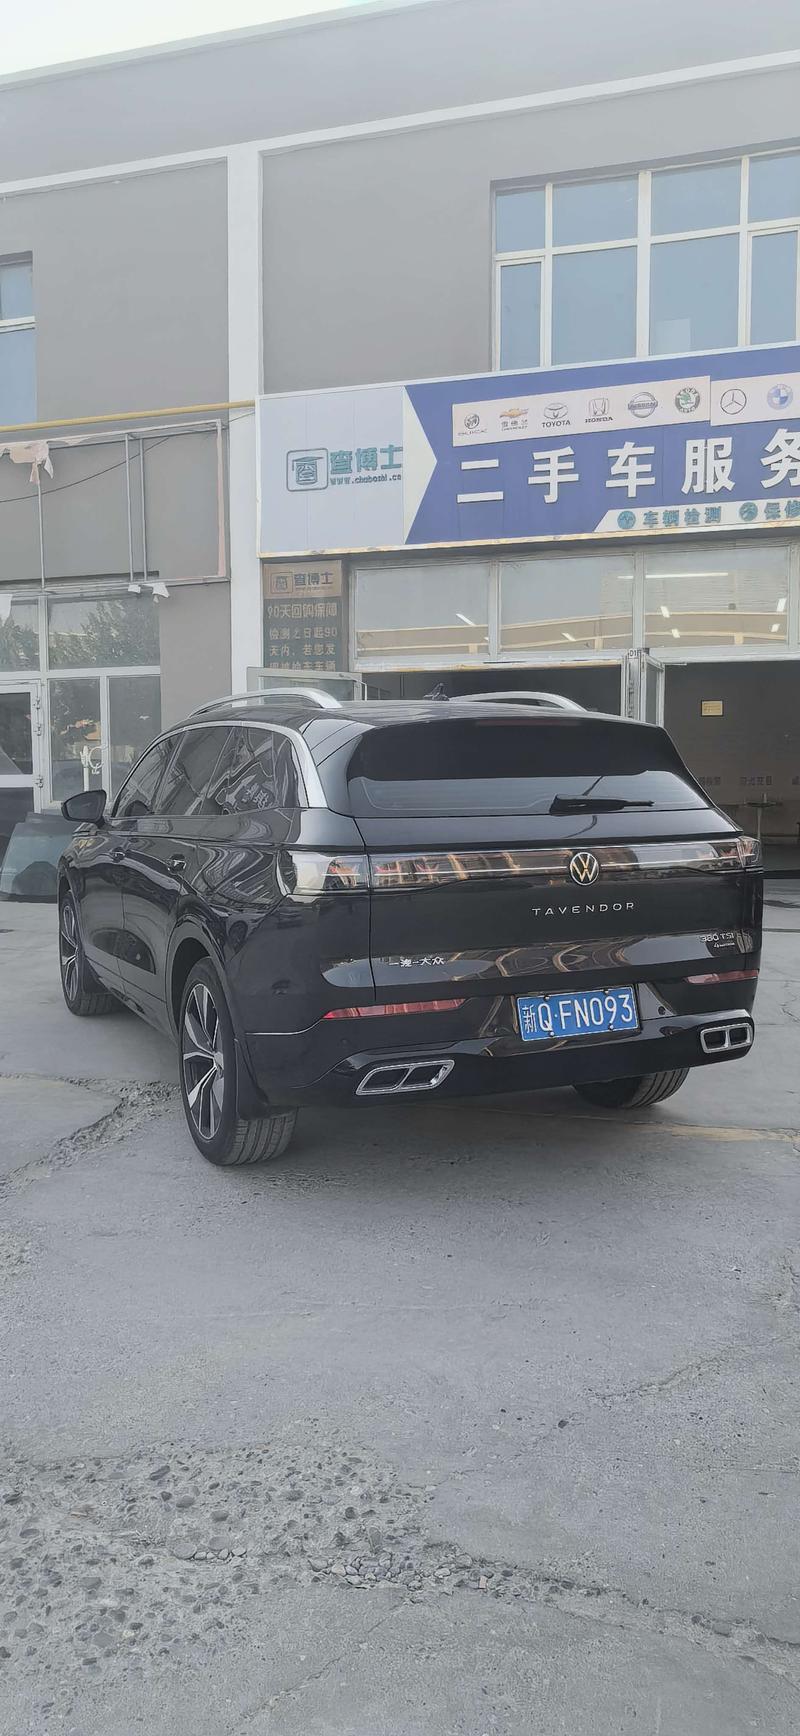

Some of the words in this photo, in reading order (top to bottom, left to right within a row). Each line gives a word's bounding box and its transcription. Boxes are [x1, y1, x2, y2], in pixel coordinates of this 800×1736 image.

[542, 420, 571, 428] TOYOTA
[585, 416, 614, 424] HONDA
[330, 445, 403, 475] 查博士
[457, 429, 800, 503] 二手车服务
[643, 506, 722, 528] 车辆检测
[532, 902, 635, 916] TAVENDOR
[700, 933, 719, 942] 380
[720, 932, 735, 940] TSI
